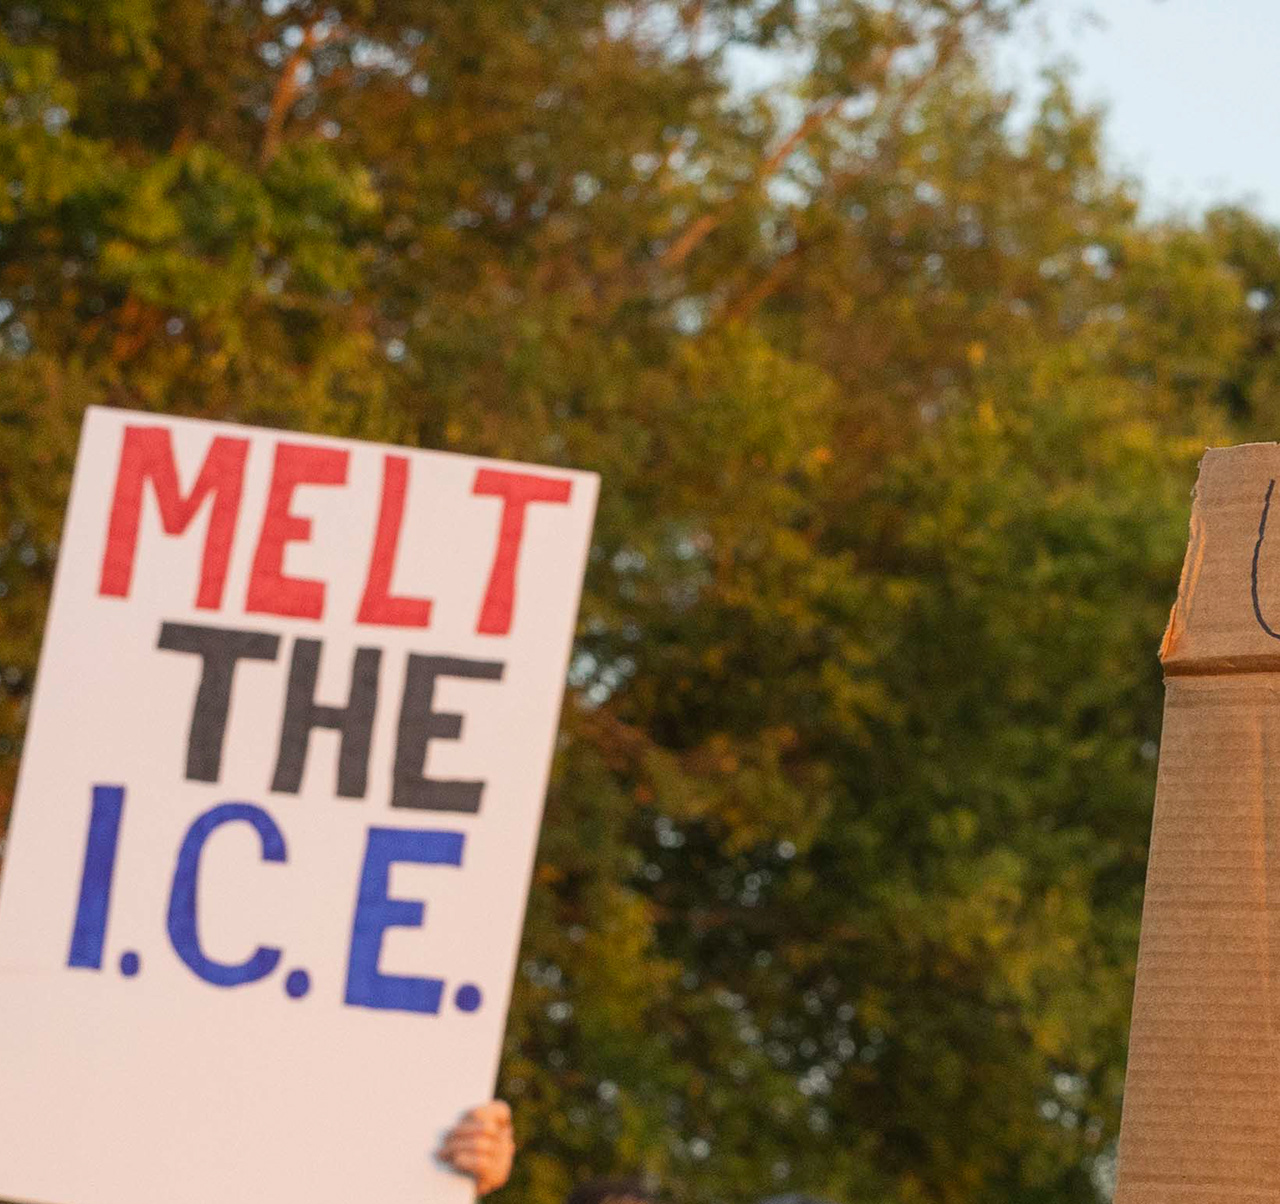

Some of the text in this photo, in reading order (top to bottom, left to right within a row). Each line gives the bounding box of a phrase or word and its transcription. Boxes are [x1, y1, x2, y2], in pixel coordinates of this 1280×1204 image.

[99, 425, 573, 636] MELT
[156, 621, 505, 814] THE
[66, 785, 483, 1016] I.C.E.
